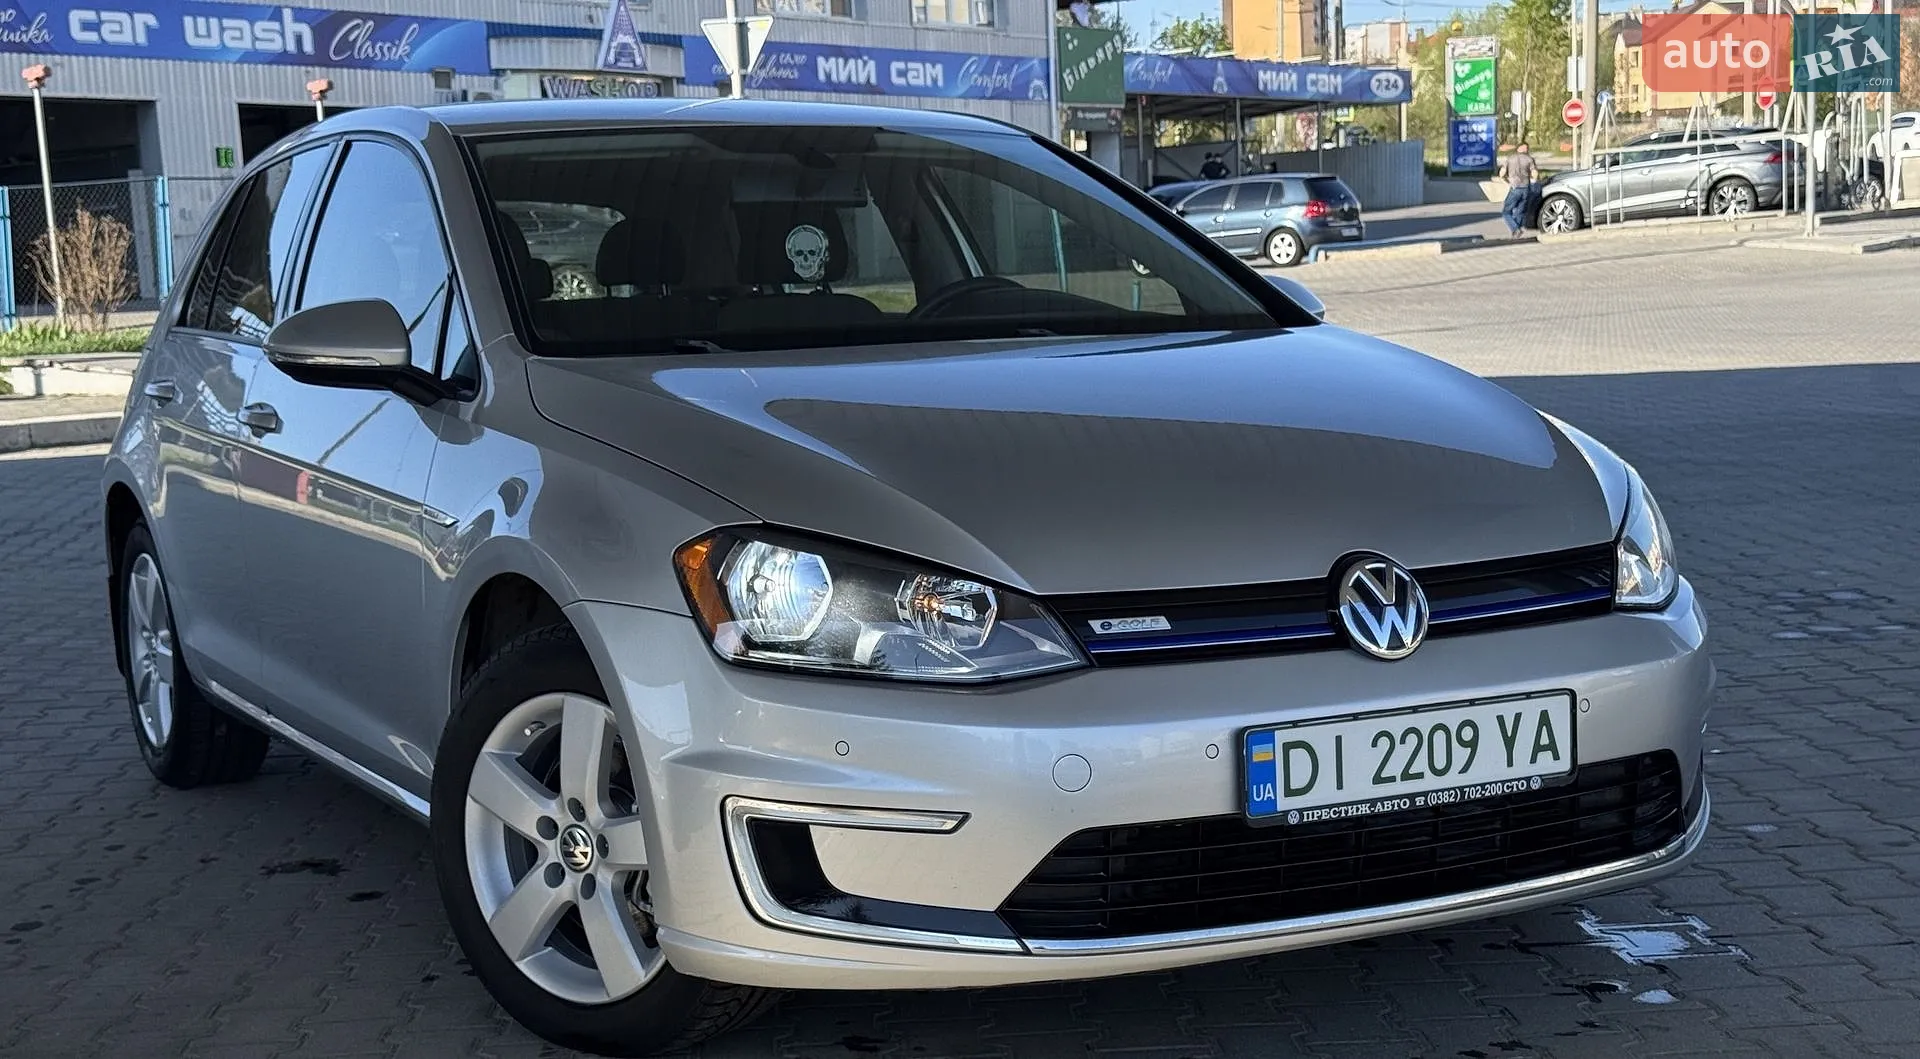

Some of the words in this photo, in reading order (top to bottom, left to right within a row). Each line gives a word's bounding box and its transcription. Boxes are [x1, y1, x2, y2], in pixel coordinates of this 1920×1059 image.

[68, 9, 159, 46] car
[183, 8, 315, 55] wash
[329, 18, 419, 62] Classik
[958, 56, 1019, 98] Comfort
[1282, 735, 1343, 798] DI
[1371, 719, 1479, 786] 2209
[1496, 709, 1560, 768] YA
[1253, 783, 1275, 801] UA
[1302, 798, 1410, 823] ПРЕСТИЖ-АВТО
[1427, 787, 1460, 807] (0382)
[1463, 781, 1502, 798] 702-200
